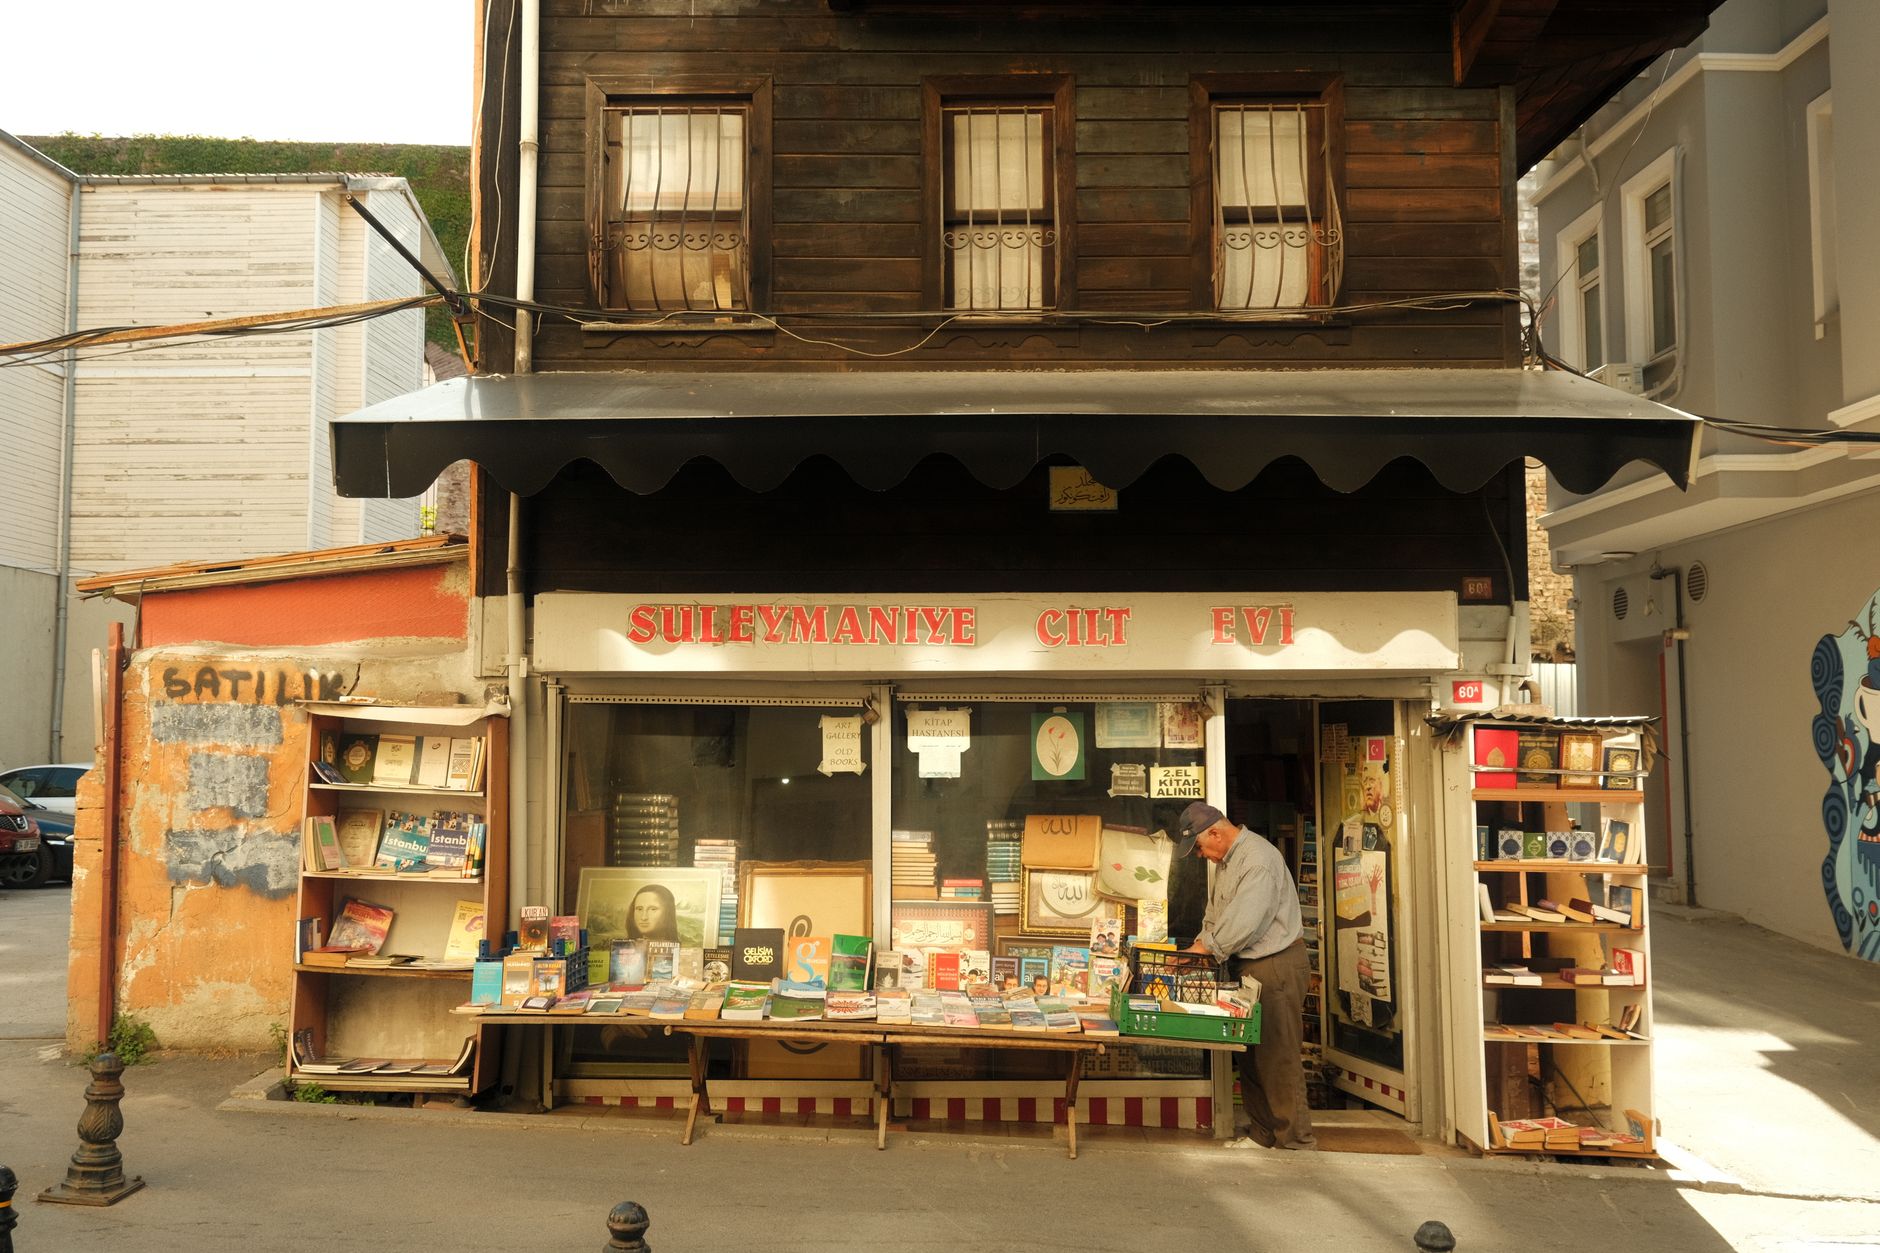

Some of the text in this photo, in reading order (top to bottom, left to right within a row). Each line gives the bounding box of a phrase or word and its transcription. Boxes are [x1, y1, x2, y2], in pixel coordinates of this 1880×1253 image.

[163, 667, 344, 706] SATILIK
[924, 717, 953, 727] KİTAP
[826, 732, 862, 740] GALLERY
[830, 758, 858, 766] BOOKS
[1163, 769, 1192, 777] 2.EL
[1158, 778, 1201, 787] KİTAP
[1157, 787, 1202, 797] ALINIR
[384, 832, 428, 853] istanbu
[431, 831, 467, 846] istanb
[744, 955, 774, 963] OXFORD
